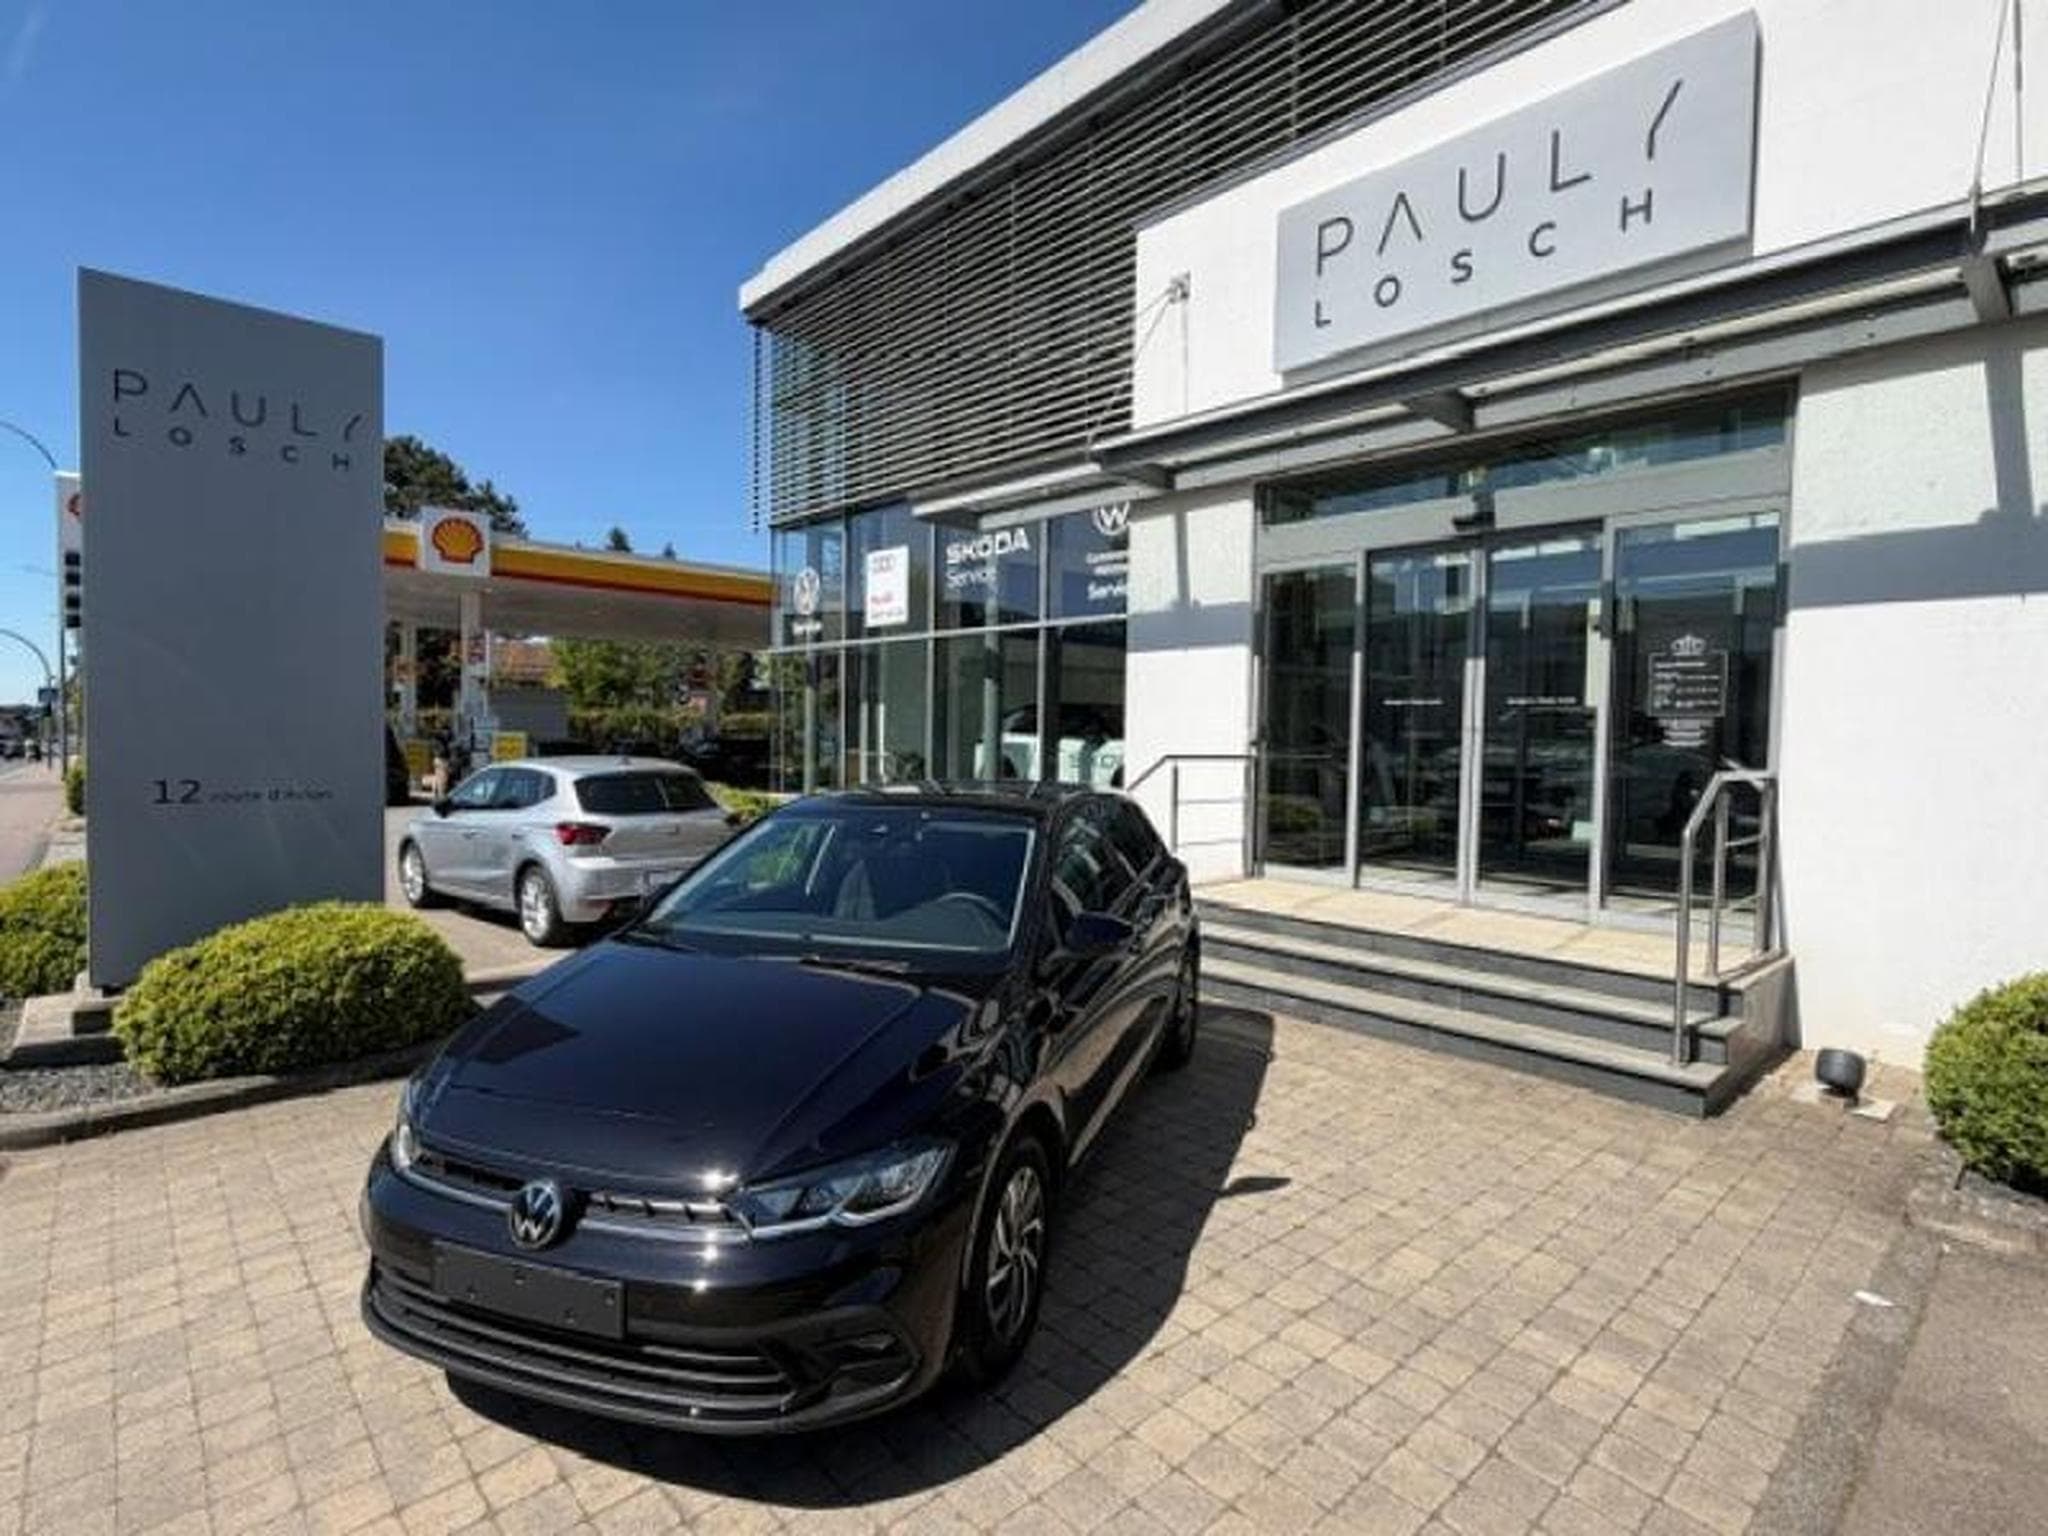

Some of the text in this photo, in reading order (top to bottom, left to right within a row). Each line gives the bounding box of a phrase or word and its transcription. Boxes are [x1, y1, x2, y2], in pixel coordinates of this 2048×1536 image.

[1316, 78, 1683, 277] PAULY
[1314, 188, 1653, 329] LOSCH
[113, 368, 363, 442] PAULY
[113, 416, 350, 472] LOSCH
[153, 779, 201, 805] 12
